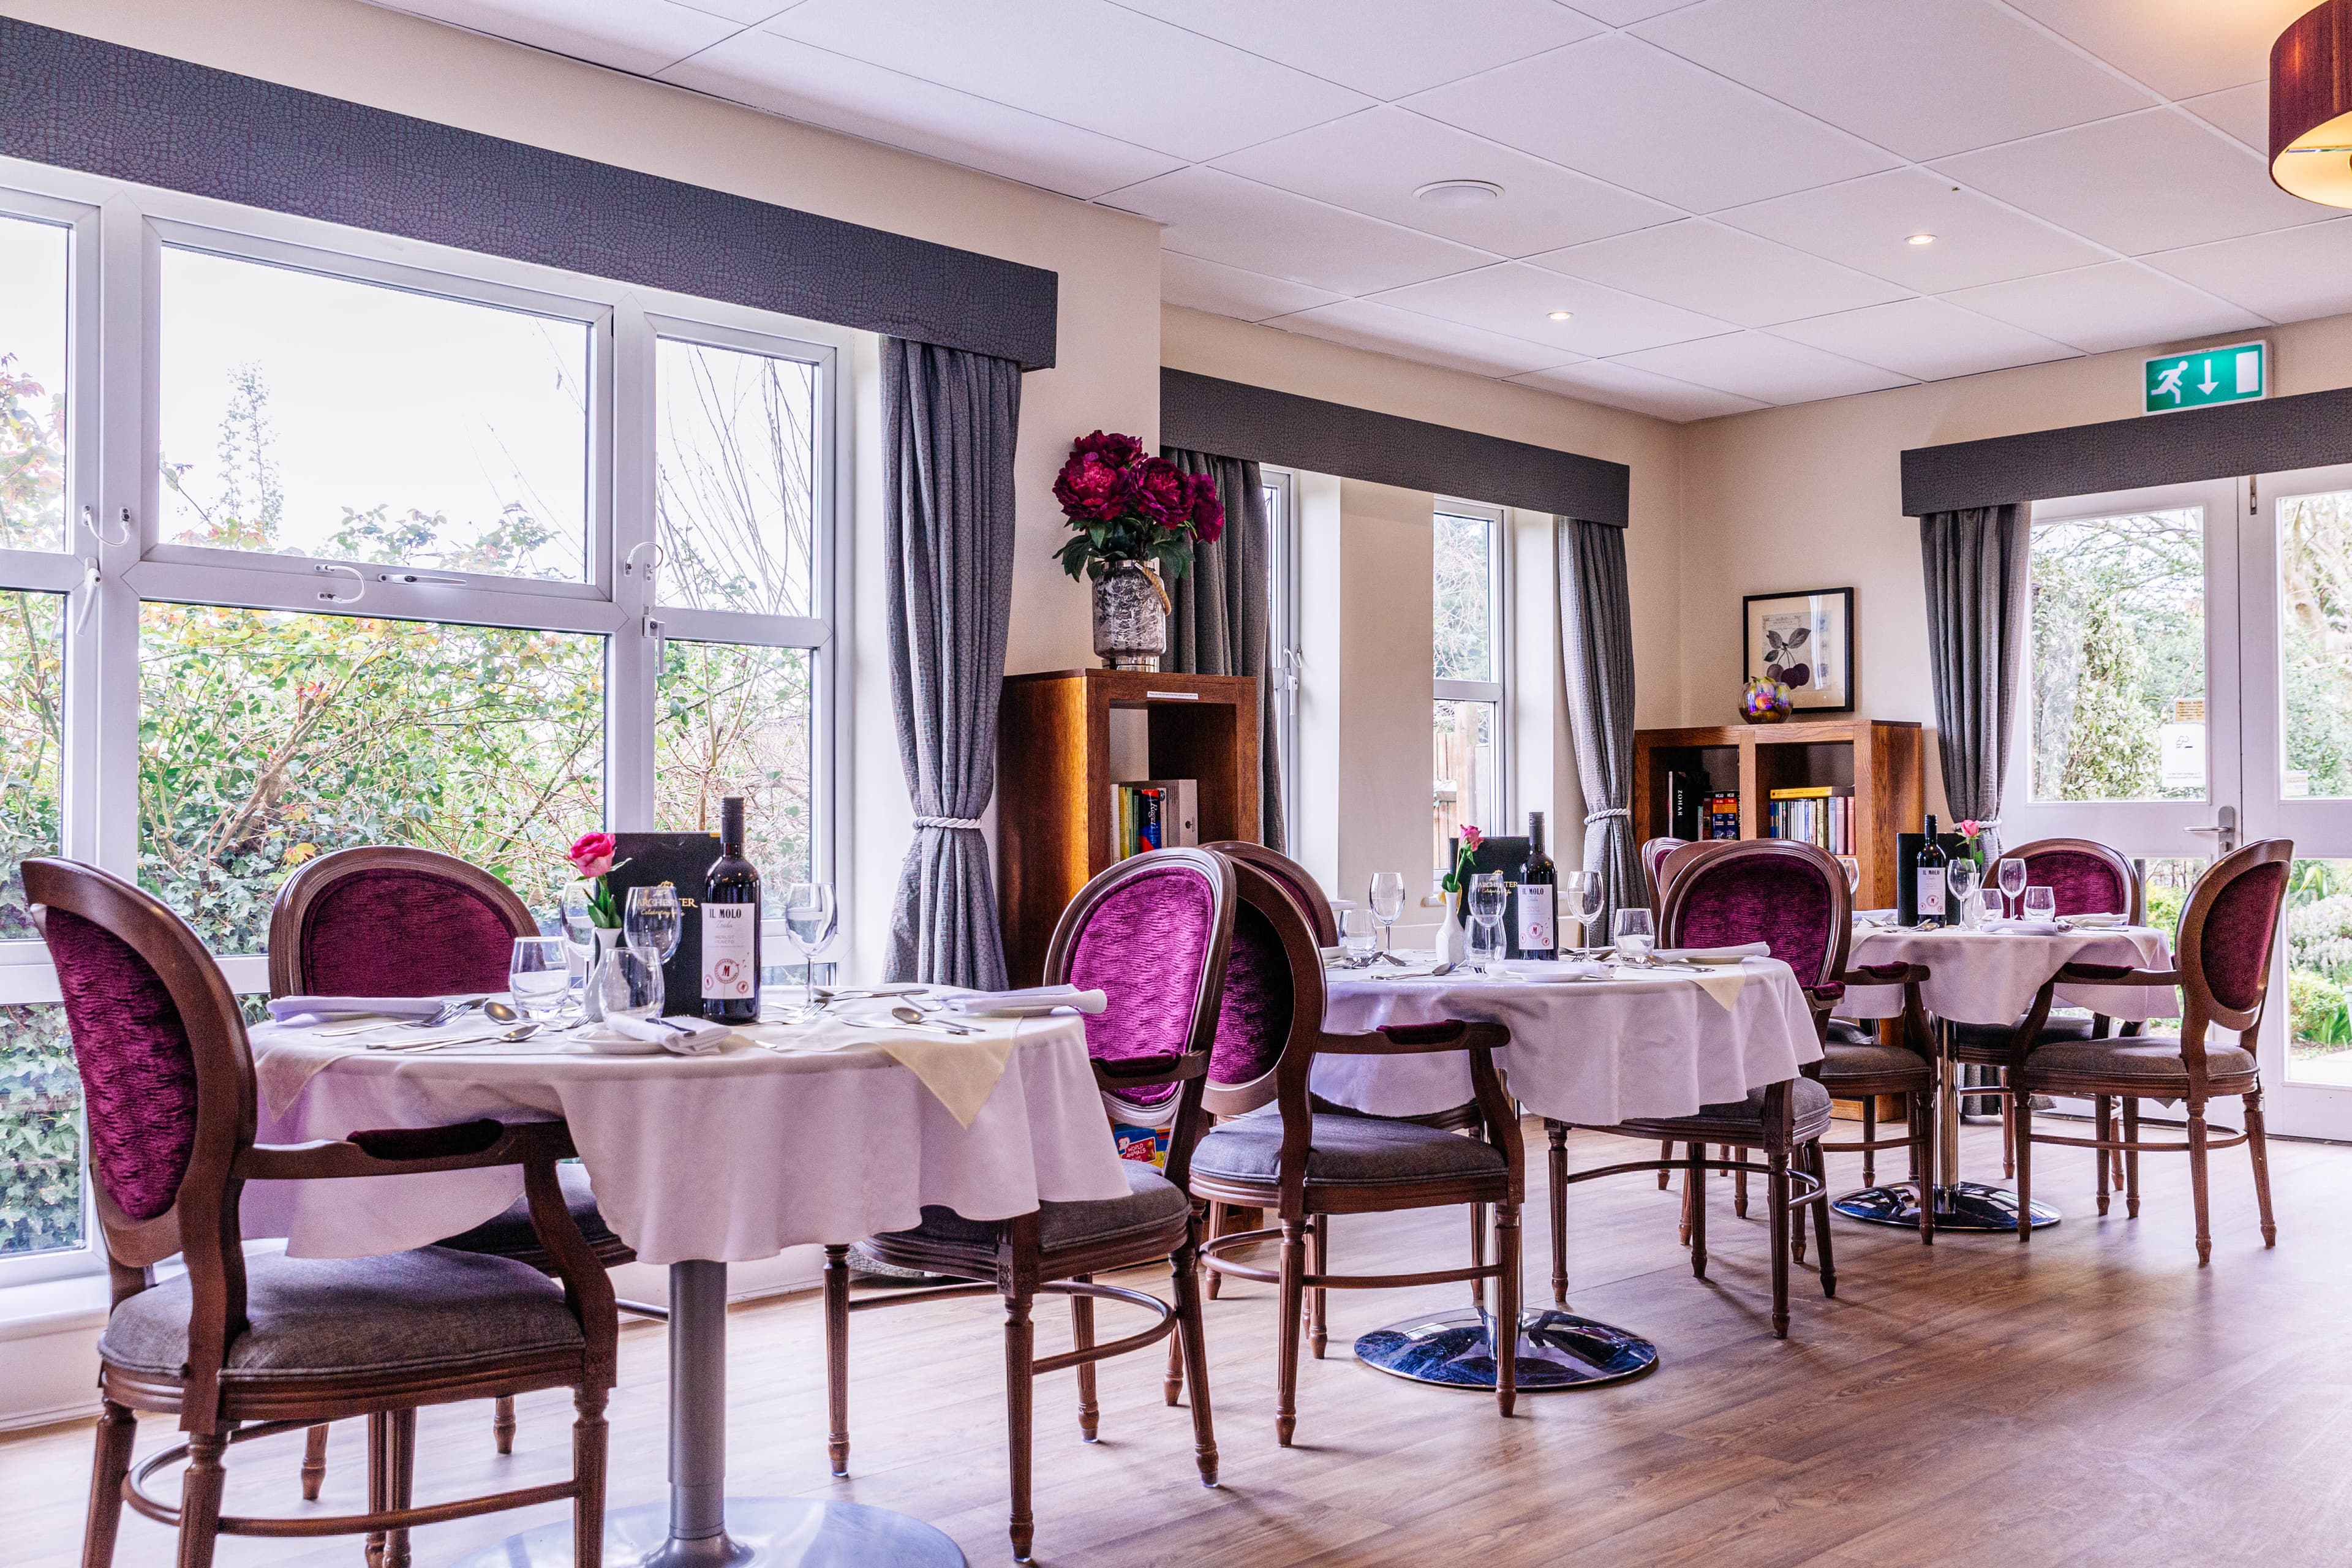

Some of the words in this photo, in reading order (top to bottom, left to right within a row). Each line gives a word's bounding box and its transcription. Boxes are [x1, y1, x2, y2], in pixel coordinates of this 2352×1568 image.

[1148, 803, 1158, 830] Roget's
[709, 908, 716, 918] IL
[719, 908, 742, 919] MOLO
[722, 965, 730, 977] M
[1126, 1147, 1146, 1158] ANIMALS
